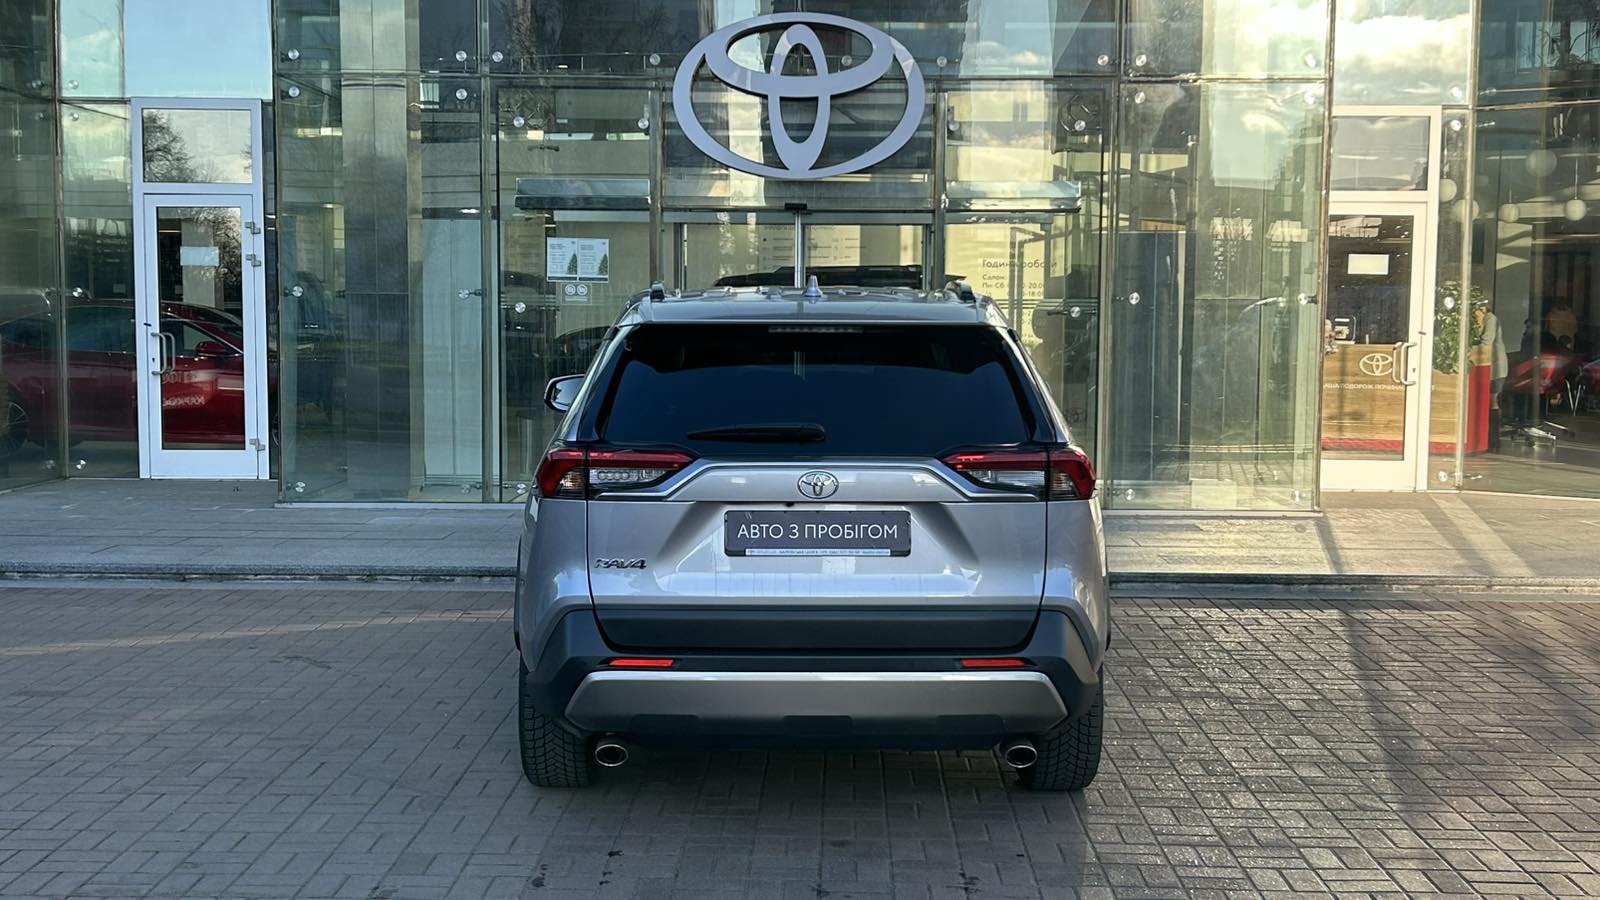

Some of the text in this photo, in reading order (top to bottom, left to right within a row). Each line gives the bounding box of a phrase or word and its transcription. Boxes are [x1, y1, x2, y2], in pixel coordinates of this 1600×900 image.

[982, 260, 1016, 269] Годин
[737, 524, 784, 539] АВТО
[804, 524, 898, 539] ПРОБІГОМ
[594, 558, 647, 569] RAV4
